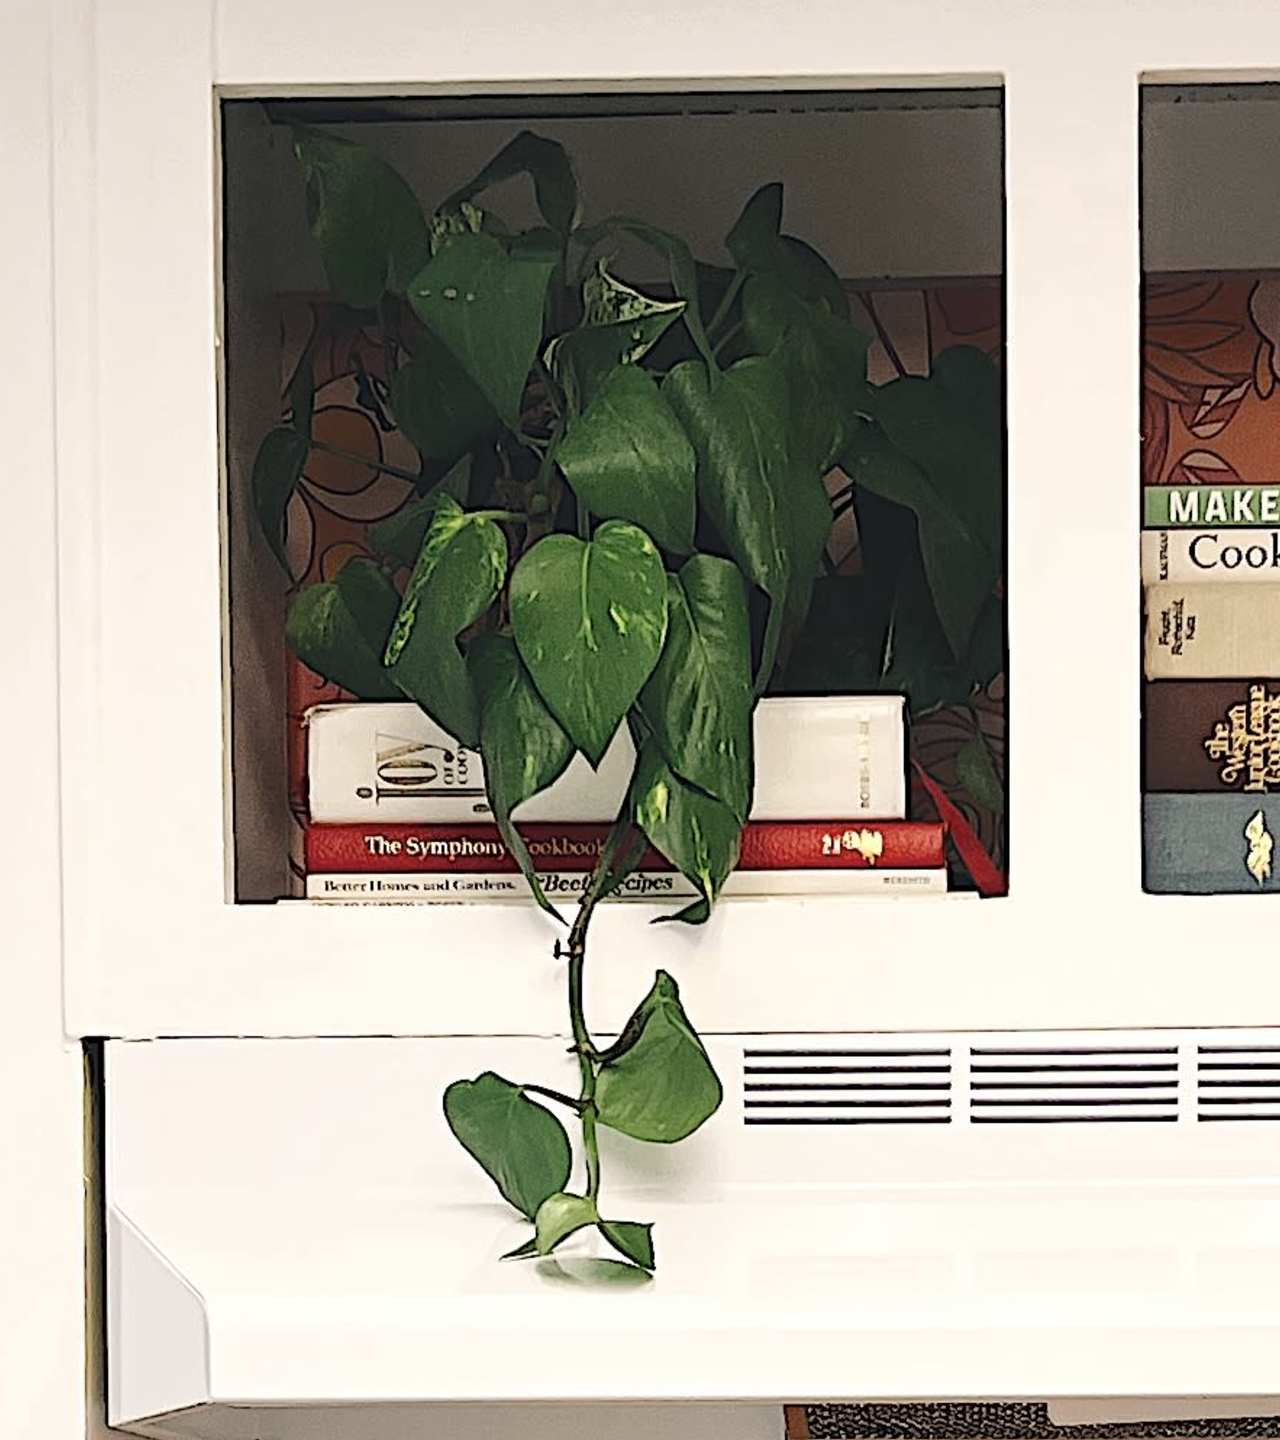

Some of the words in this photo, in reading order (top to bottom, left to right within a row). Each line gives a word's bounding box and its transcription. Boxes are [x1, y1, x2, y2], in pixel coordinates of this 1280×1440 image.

[1168, 489, 1280, 523] MAKE
[365, 836, 401, 855] The
[406, 836, 505, 862] Symphony
[522, 836, 606, 856] ookbook
[324, 880, 367, 892] Better
[370, 880, 420, 892] Homes
[423, 879, 450, 892] and
